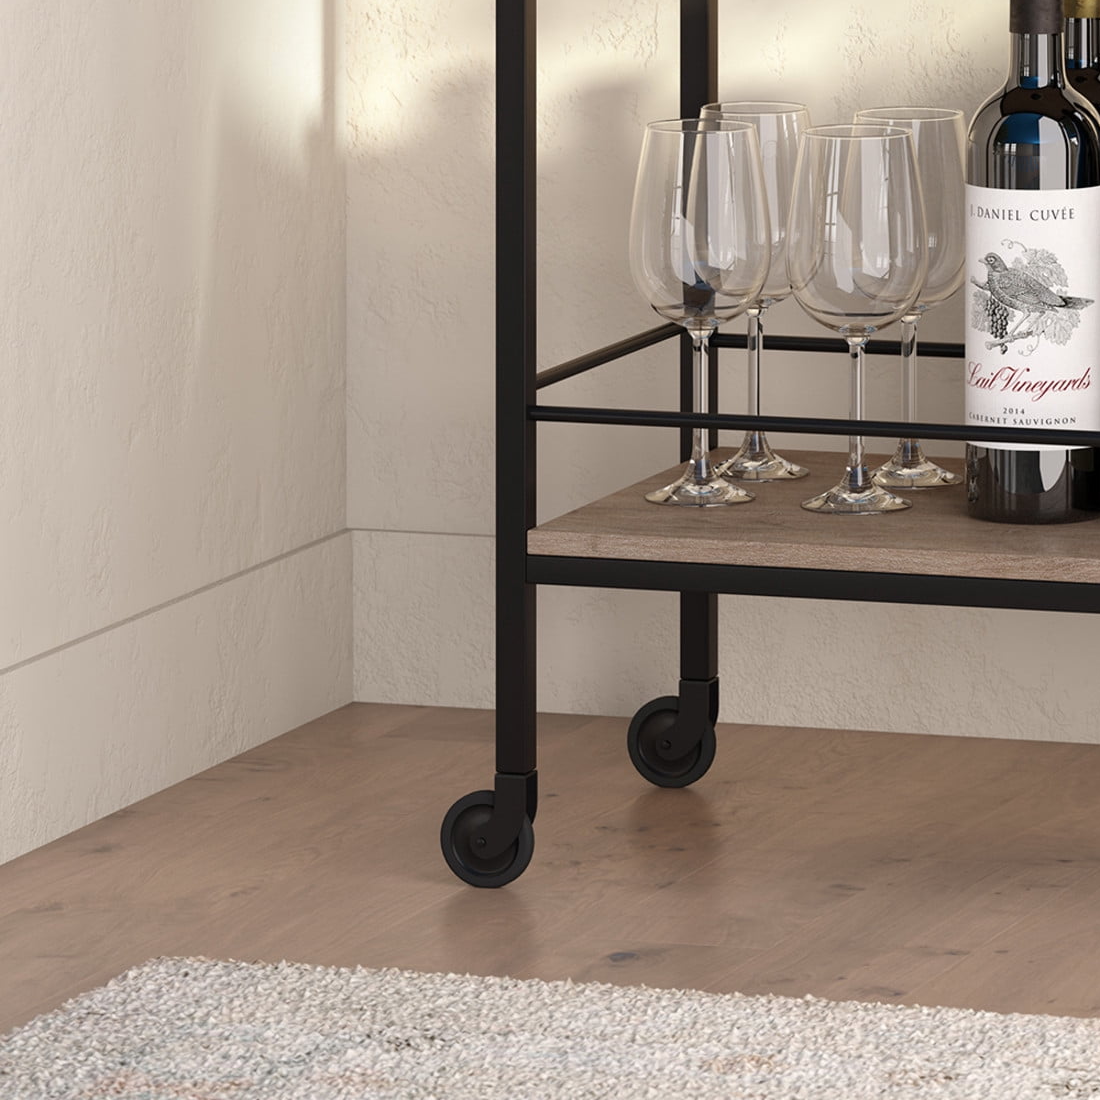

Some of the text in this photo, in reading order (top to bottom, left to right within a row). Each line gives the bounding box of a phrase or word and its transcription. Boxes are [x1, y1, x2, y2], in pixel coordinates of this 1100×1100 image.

[977, 206, 1022, 221] DANIEL
[1029, 207, 1075, 221] CUVÉE
[999, 367, 1091, 402] Vineyards
[1002, 407, 1025, 415] 2014
[969, 412, 1076, 426] CABERNET SAUVIGNON
